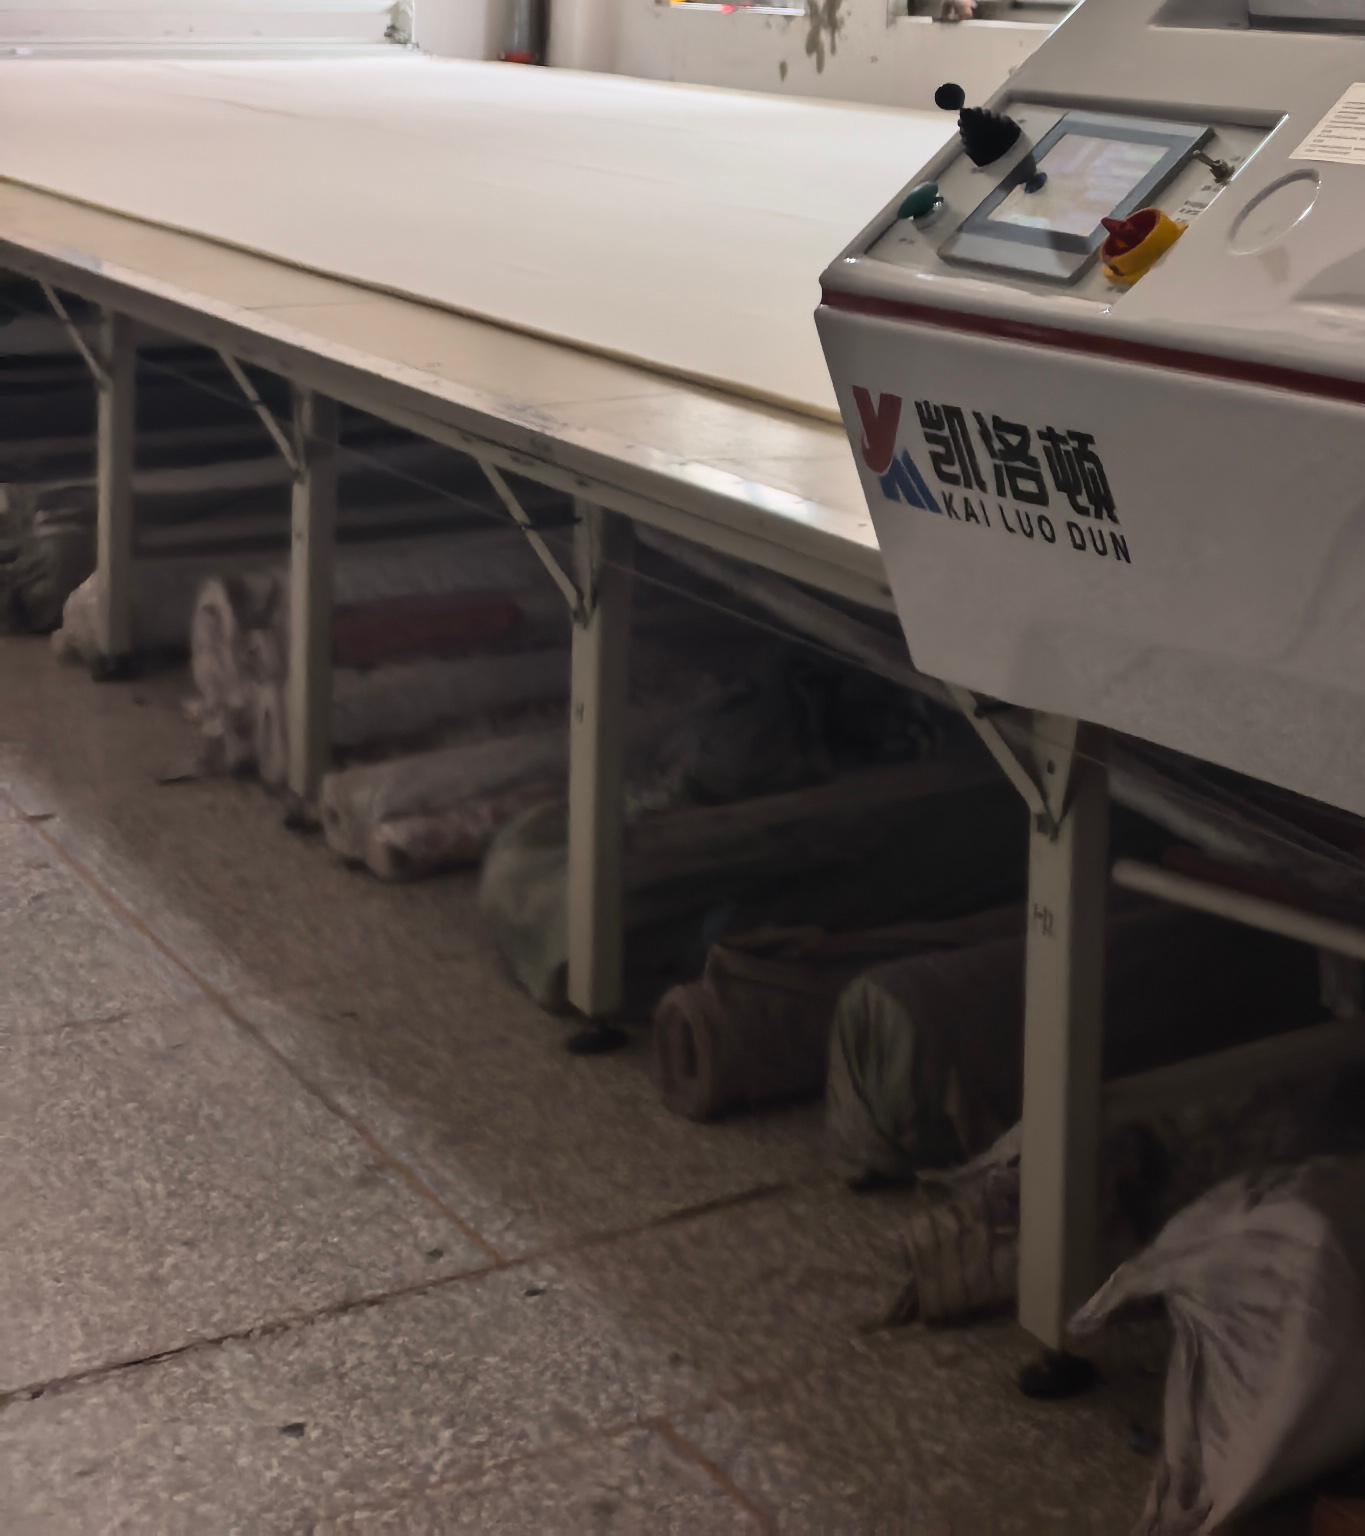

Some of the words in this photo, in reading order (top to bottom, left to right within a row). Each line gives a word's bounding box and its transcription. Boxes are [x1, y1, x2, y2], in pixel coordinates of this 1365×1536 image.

[914, 400, 1119, 524] 凯洛顿
[942, 491, 991, 527] KAI
[998, 504, 1056, 544] LUO
[1066, 521, 1132, 564] DUN
